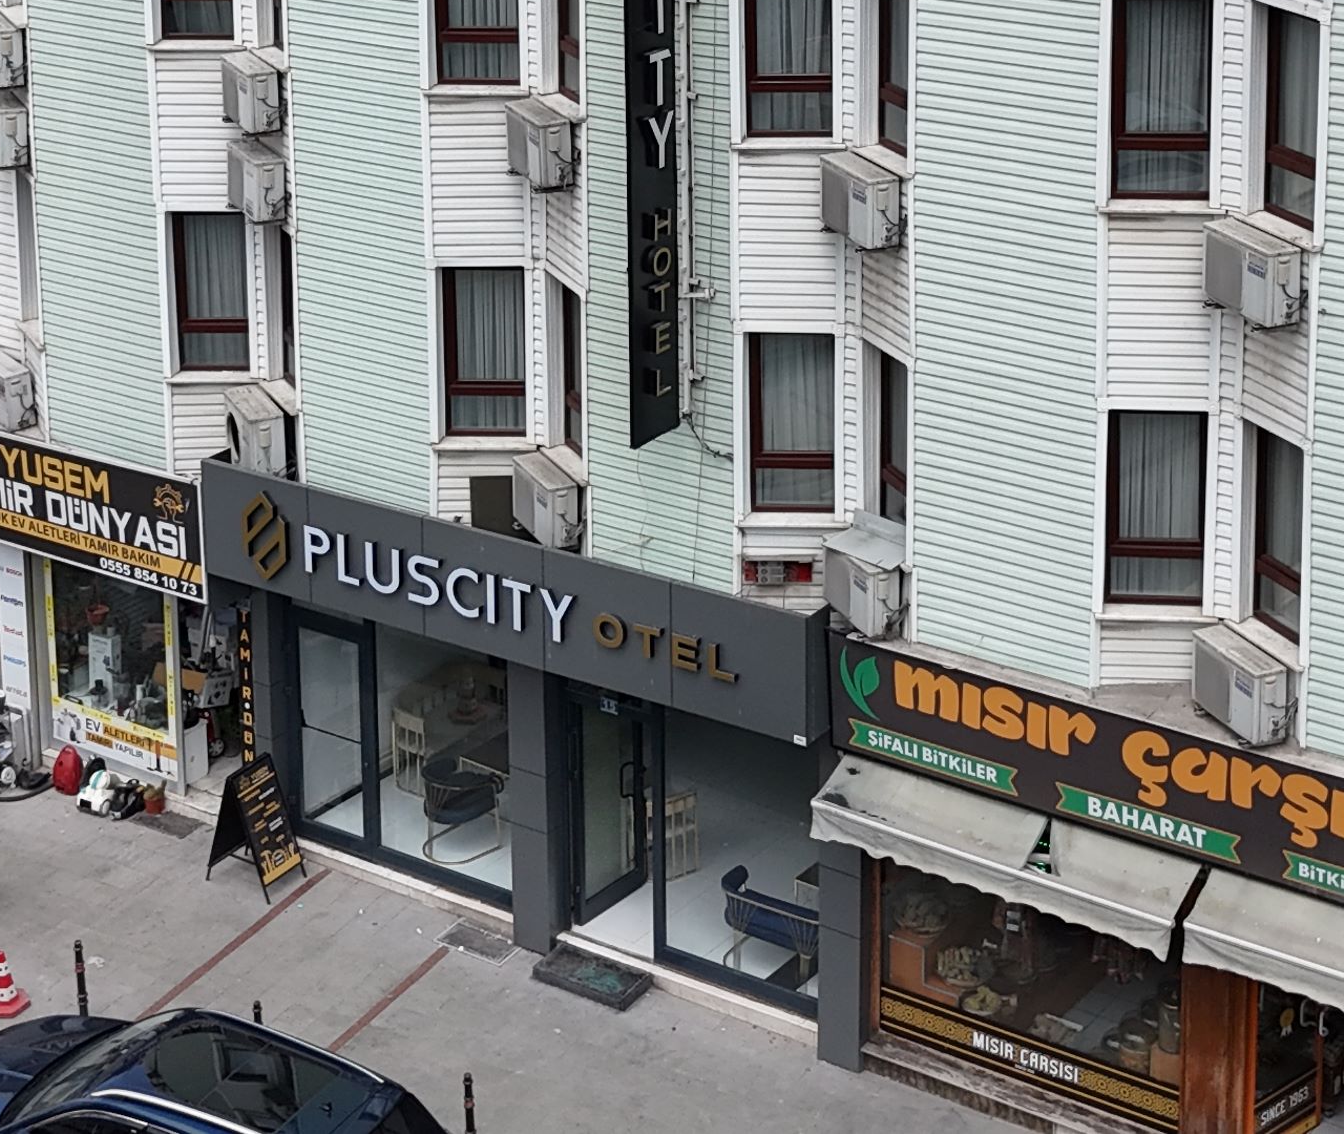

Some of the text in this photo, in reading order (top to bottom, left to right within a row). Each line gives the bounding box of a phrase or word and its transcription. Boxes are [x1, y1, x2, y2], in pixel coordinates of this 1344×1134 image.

[654, 208, 673, 398] HOTEL
[11, 514, 26, 527] EV
[28, 516, 81, 545] ALETLERİ
[82, 535, 119, 558] TAMİR
[121, 546, 161, 569] BAKIM
[45, 490, 187, 560] DÜNYASI
[99, 557, 198, 596] 0555 854 10 73
[303, 524, 740, 684] PLUSCITY OTEL
[85, 718, 101, 732] EV
[1087, 796, 1207, 849] BAHARAT
[972, 1030, 1079, 1085] MISIR ÇARŞISI
[1260, 1086, 1310, 1127] SINCE 1963
